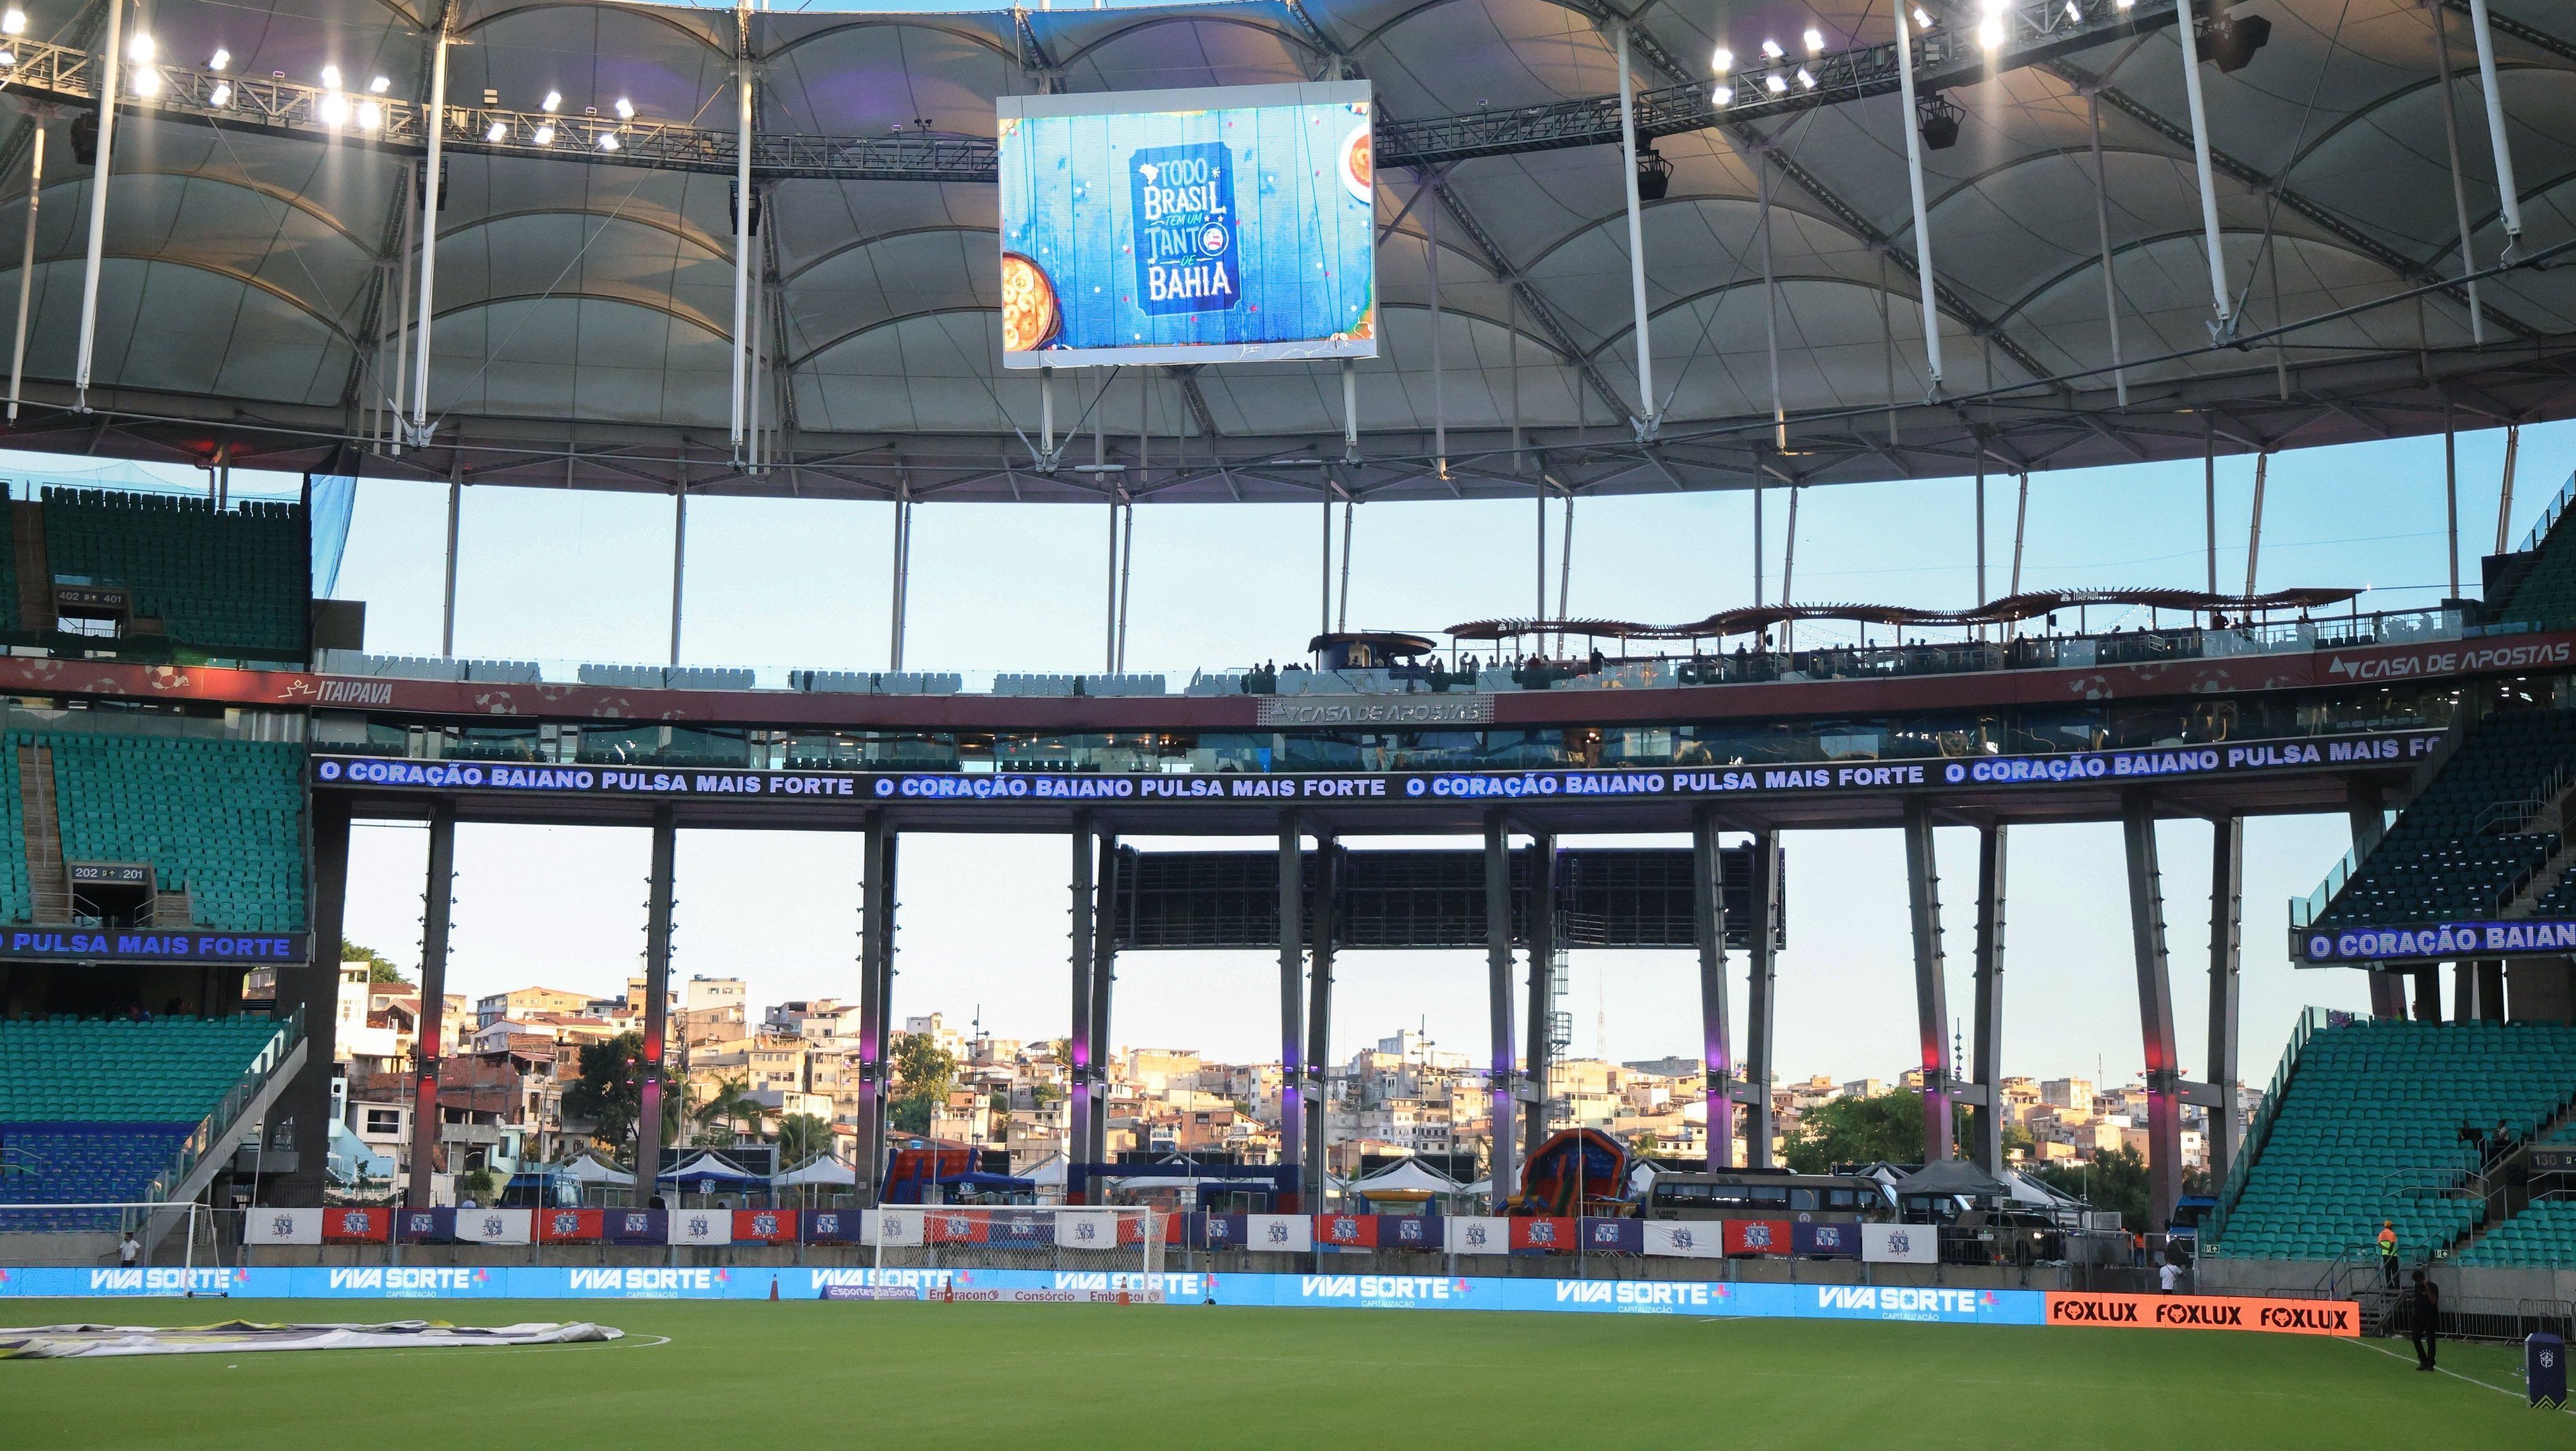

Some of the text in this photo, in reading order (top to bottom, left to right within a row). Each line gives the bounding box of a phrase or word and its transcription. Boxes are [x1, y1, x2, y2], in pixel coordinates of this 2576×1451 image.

[1157, 158, 1208, 186] TODO
[1143, 181, 1226, 220] BRASIL
[1165, 213, 1202, 226] TEM UM
[1180, 255, 1195, 267] DE
[1148, 261, 1232, 301] BAHIA
[59, 591, 79, 601] 402
[104, 594, 121, 603] 401
[2074, 591, 2099, 601] ITAIPAVA
[2361, 643, 2570, 678] CASA DE APOSTAS
[317, 680, 392, 704] ITAIPAVA
[1299, 704, 1480, 722] CASA DE APOSTAS
[1945, 764, 1965, 782] O
[1976, 755, 2106, 782] CORAÇÃO
[2114, 750, 2219, 776] BAIANO
[2228, 744, 2321, 767] PULSA
[2329, 739, 2399, 760] MAIS
[319, 761, 853, 794] O CORAÇÃO BAIANO PULSA MAIS FORTE
[875, 776, 1385, 798] O CORAÇÃO BAIANO PULSA MAIS FORTE
[1407, 765, 1924, 797] O CORAÇÃO BAIANO PULSA MAIS FORTE
[75, 869, 97, 877] 202
[123, 870, 142, 879] 201
[13, 933, 108, 952] PULSA
[118, 935, 189, 955] MAIS
[199, 937, 289, 955] FORTE
[2311, 925, 2575, 956] O CORAÇÃO BAIAN
[2534, 1154, 2557, 1166] 130
[91, 1269, 230, 1289] VIVA SORTE
[330, 1268, 381, 1288] VIVA
[570, 1269, 621, 1289] VIVA
[812, 1269, 953, 1289] VIVA SORTE
[1055, 1273, 1107, 1289] VIVA
[1302, 1276, 1355, 1298] VIVA
[930, 1289, 987, 1300] Emracon
[1015, 1291, 1075, 1301] Consórcio
[1557, 1281, 1611, 1303] VIVA
[1819, 1286, 1876, 1309] VIVA
[1361, 1299, 1414, 1308] CAPITALIZAÇÃO
[1618, 1306, 1672, 1314] CAPITALIZAÇÃO
[2053, 1300, 2138, 1321] FOXLUX
[1882, 1312, 1940, 1320] CAPITALIZAÇÃO
[2157, 1303, 2241, 1325] FOXLUX
[2260, 1306, 2348, 1330] FOXLUX
